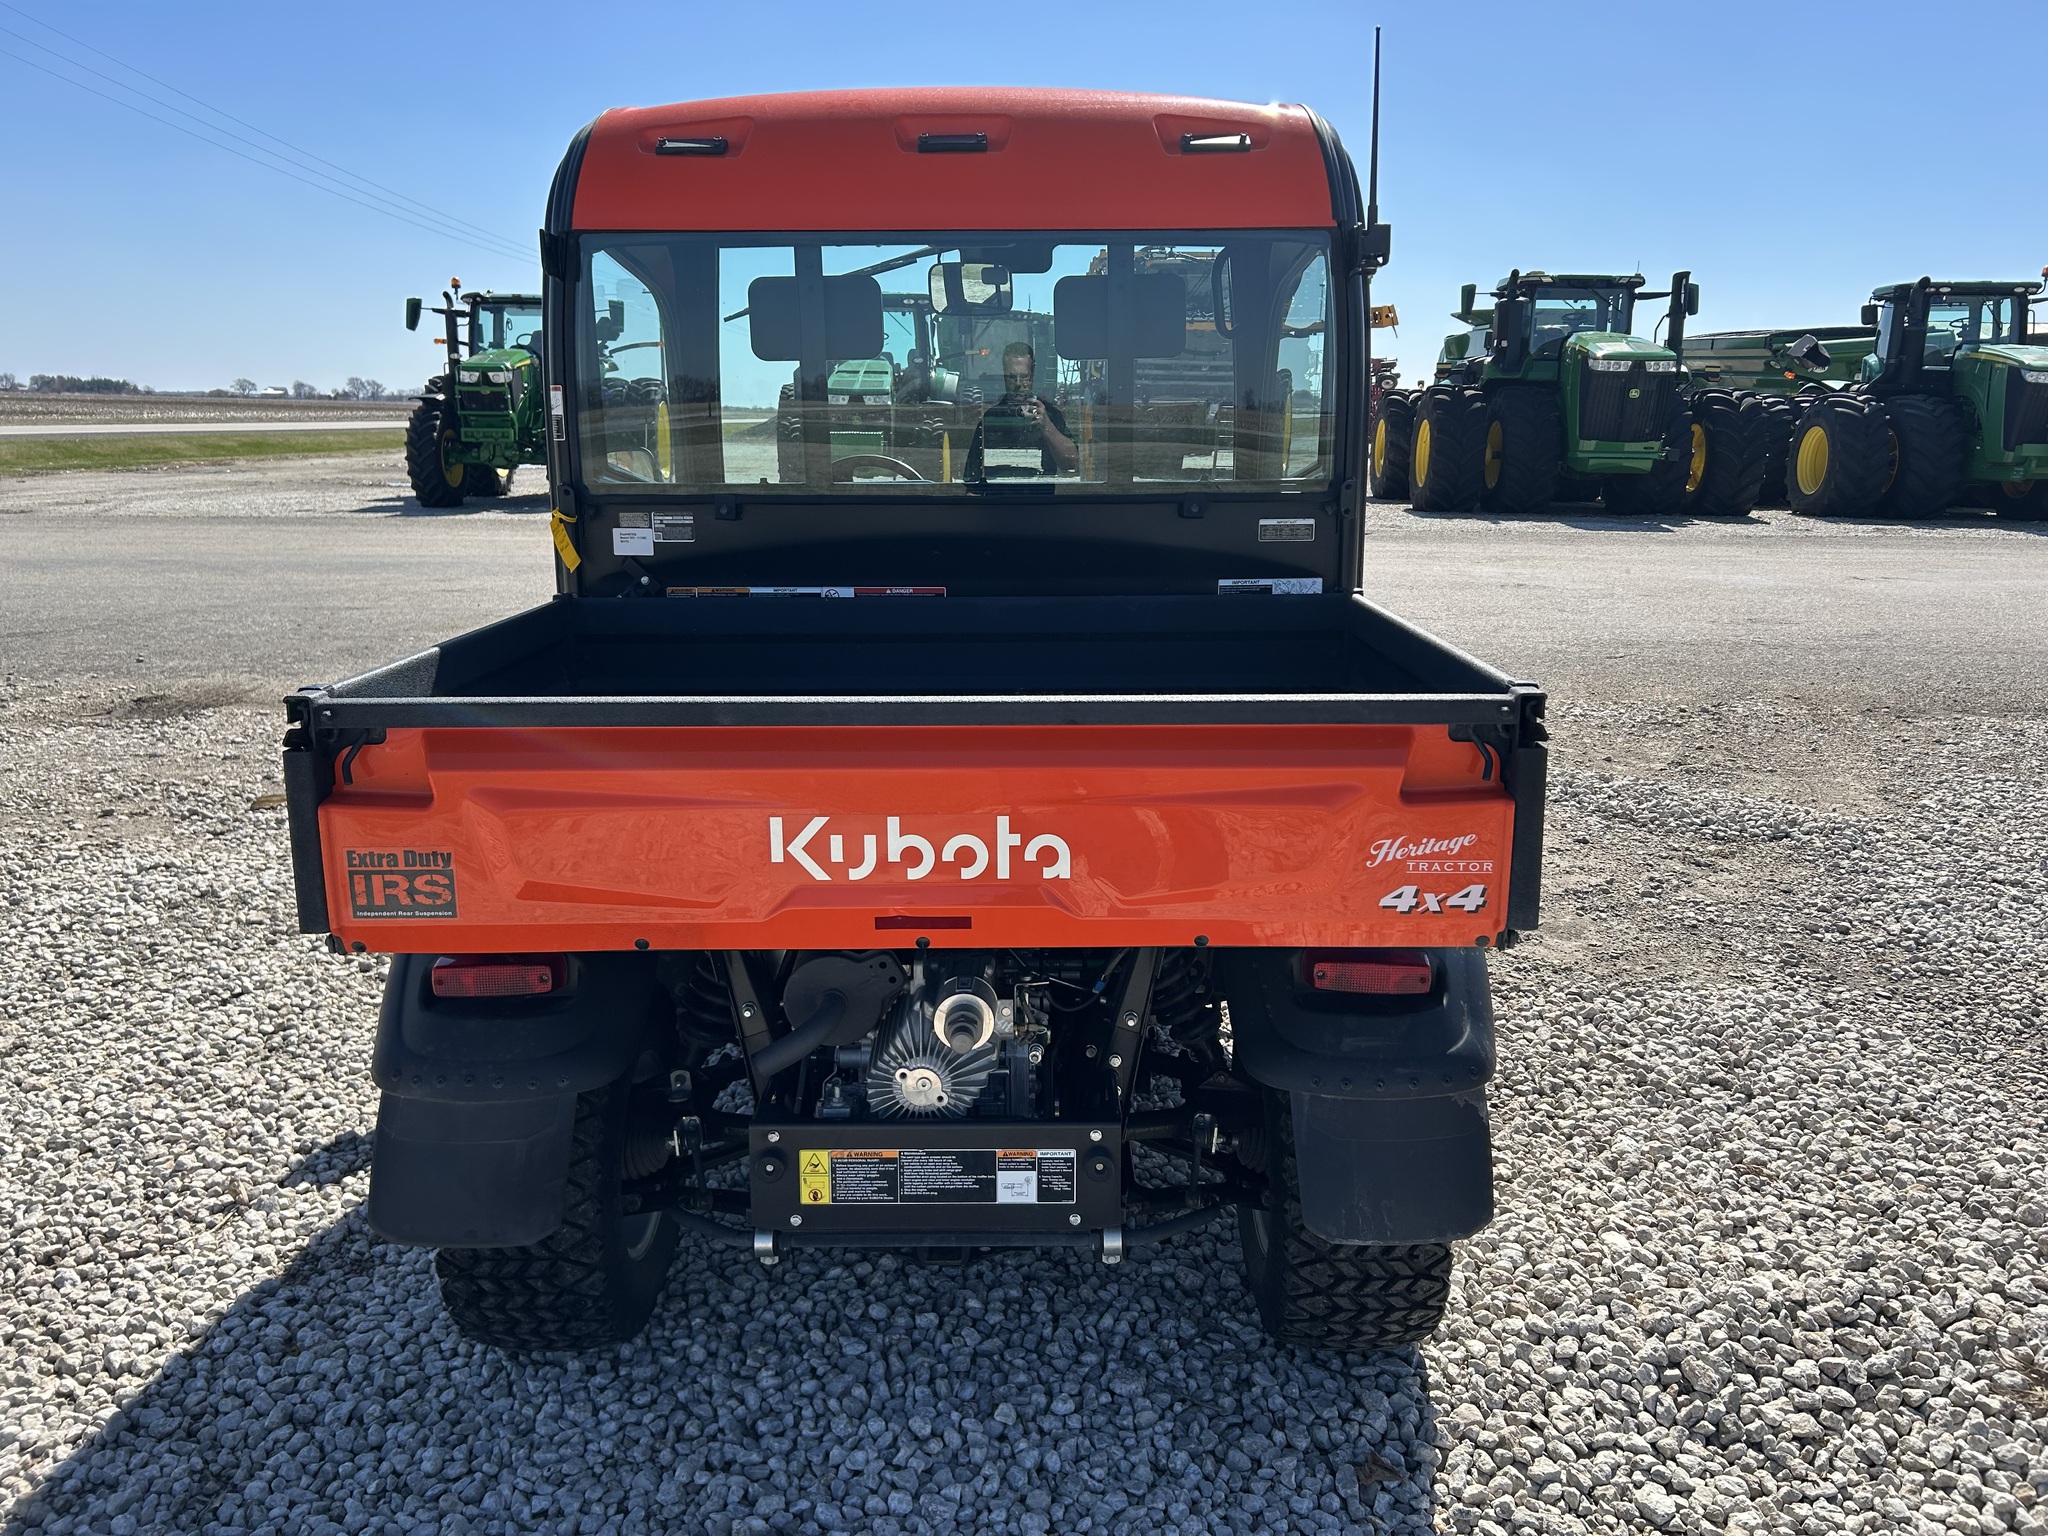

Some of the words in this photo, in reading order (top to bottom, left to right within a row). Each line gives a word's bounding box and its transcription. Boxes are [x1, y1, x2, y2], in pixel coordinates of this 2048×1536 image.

[346, 850, 399, 868] Extra
[403, 849, 453, 869] Duty
[769, 815, 1071, 881] Kubota
[1366, 833, 1478, 868] Heritage
[1406, 862, 1493, 872] TRACTOR
[353, 874, 453, 906] IRS
[1378, 884, 1488, 915] 4x4
